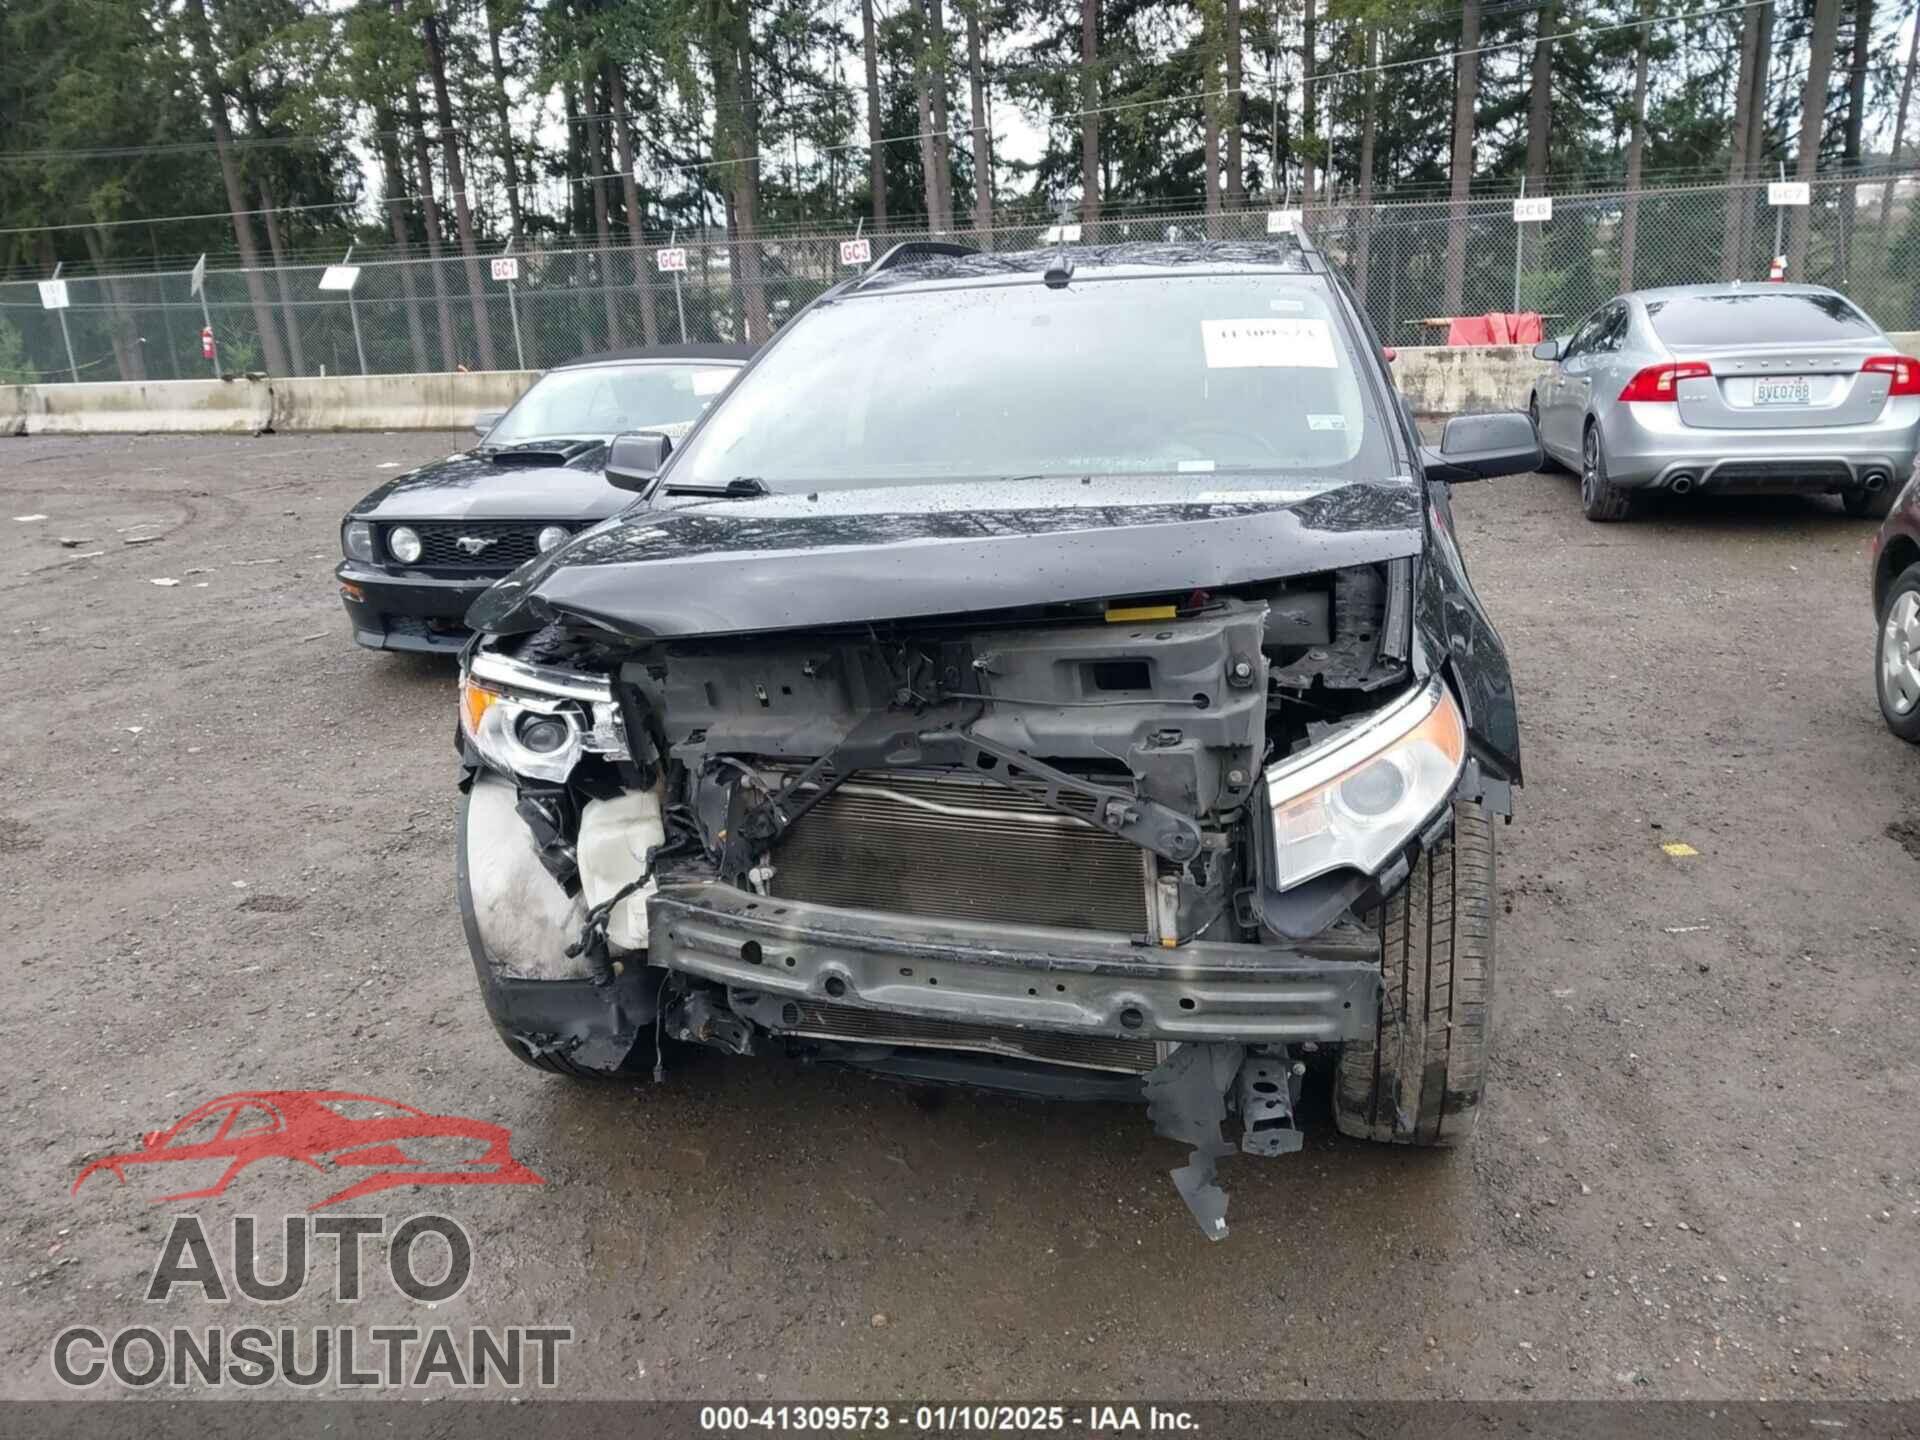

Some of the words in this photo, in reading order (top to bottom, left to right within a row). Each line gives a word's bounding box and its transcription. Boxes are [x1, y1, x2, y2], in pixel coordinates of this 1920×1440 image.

[660, 251, 684, 269] GC2
[843, 242, 868, 261] GC3
[493, 261, 513, 277] GC1
